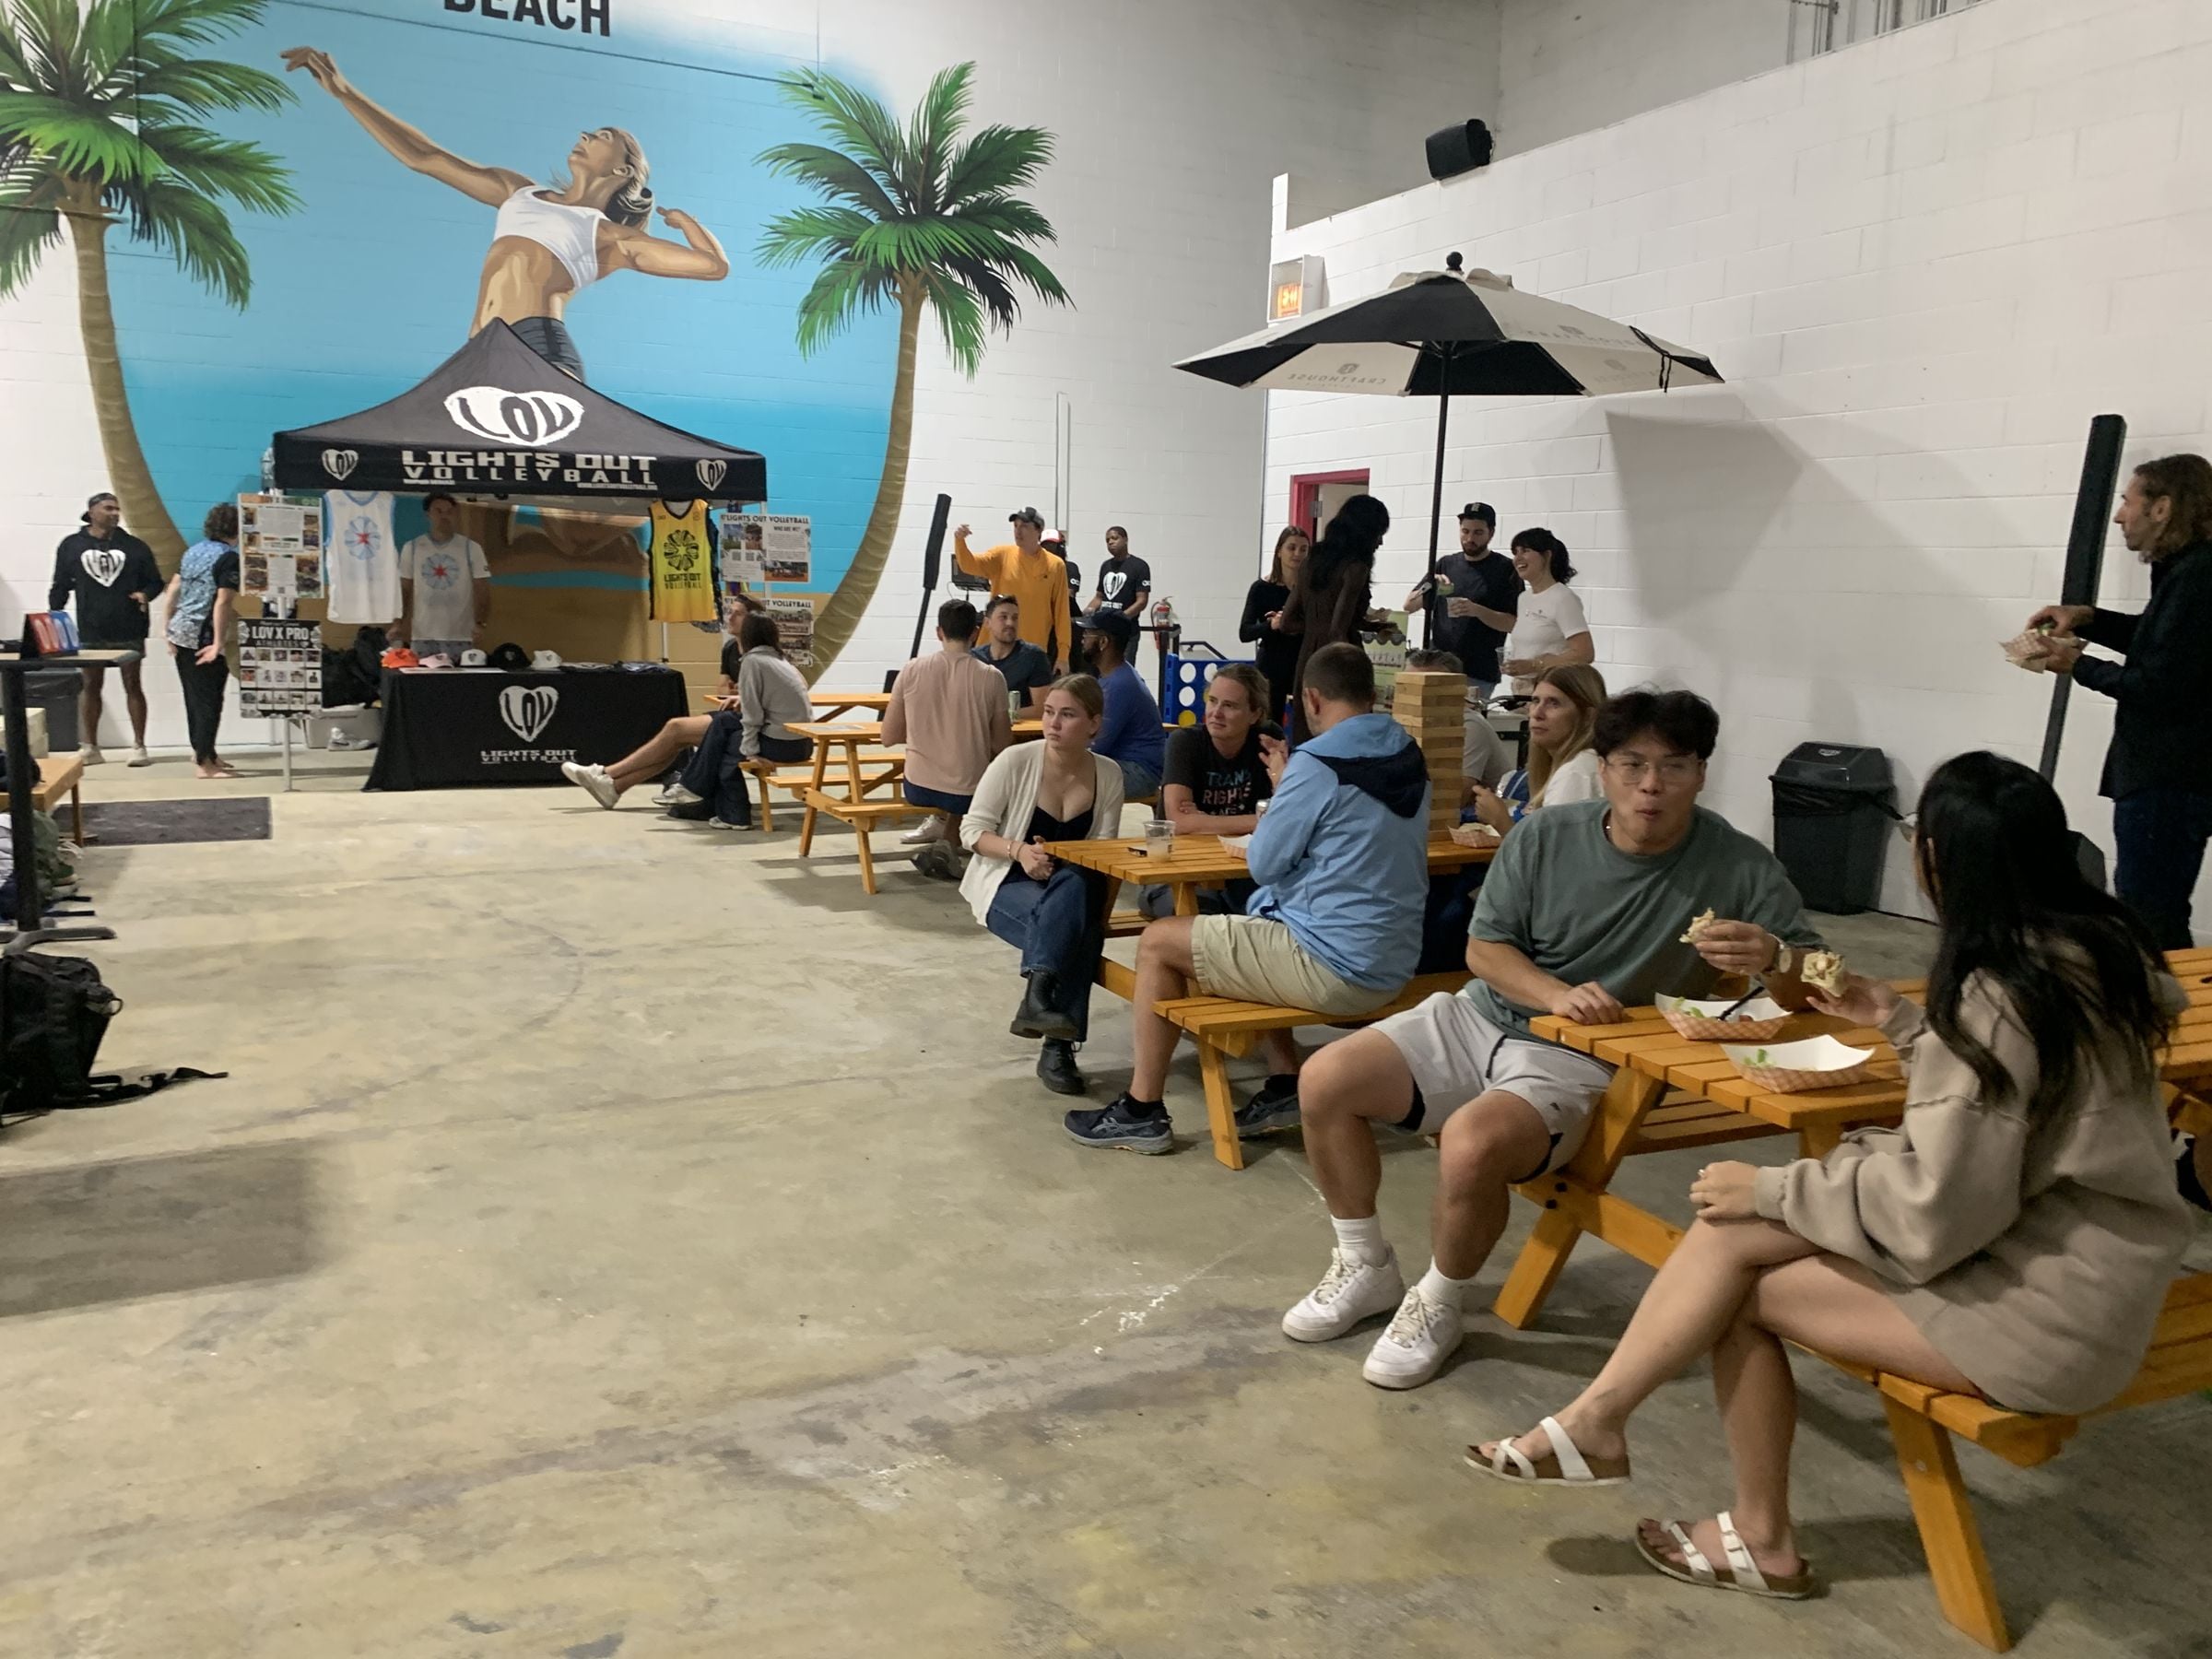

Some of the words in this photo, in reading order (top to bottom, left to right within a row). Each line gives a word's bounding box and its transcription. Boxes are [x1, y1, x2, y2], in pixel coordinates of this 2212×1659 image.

[444, 0, 610, 36] ACH
[456, 395, 575, 443] LOV
[402, 450, 560, 468] LIGHTS
[575, 453, 657, 471] OUT
[403, 465, 657, 485] VOLLEYBALL
[769, 516, 809, 524] VOLLEYBALL
[772, 600, 812, 608] VOLLEYBALL
[252, 626, 275, 640] LOV
[275, 627, 284, 641] X
[286, 627, 310, 641] PRO
[504, 690, 554, 736] LOV
[481, 755, 578, 763] VOLLEYBALL
[545, 748, 578, 757] OUT
[1206, 769, 1252, 787] TRANS
[1202, 782, 1252, 805] RIGHTS
